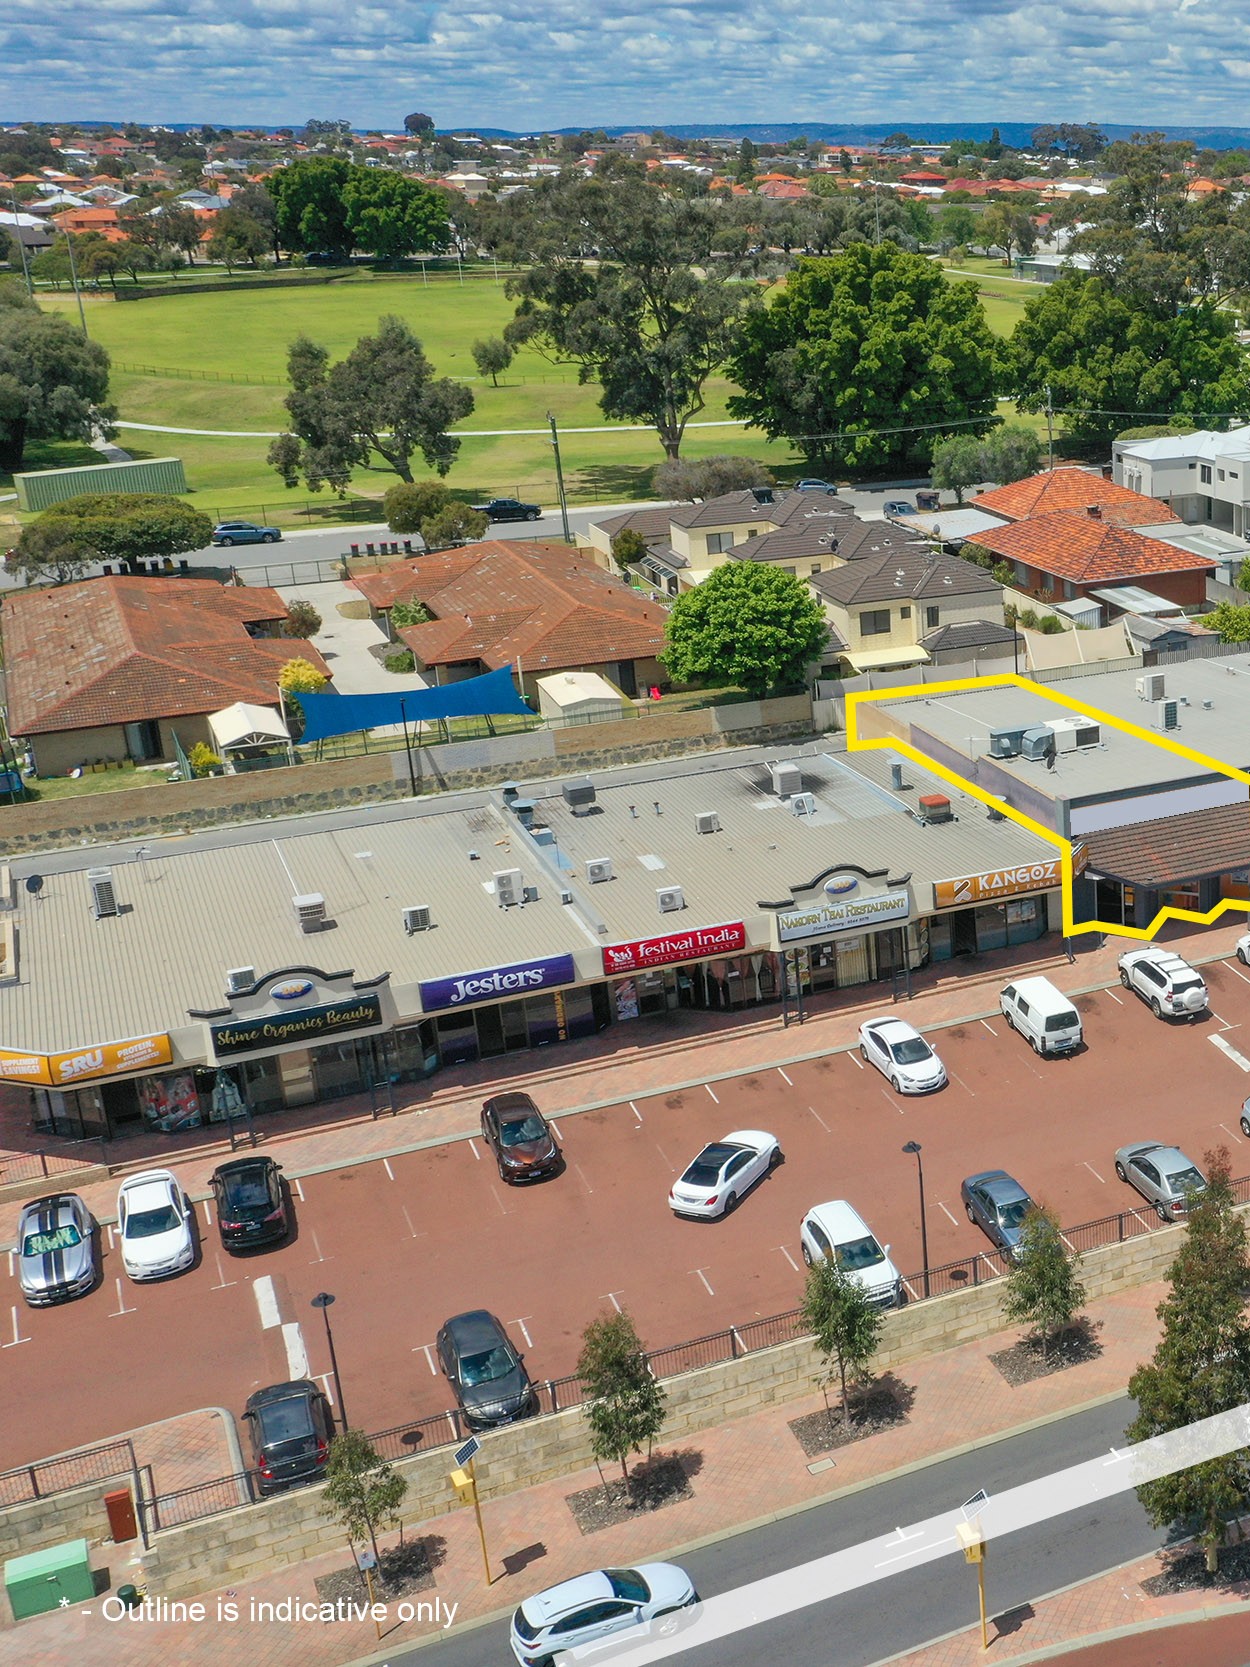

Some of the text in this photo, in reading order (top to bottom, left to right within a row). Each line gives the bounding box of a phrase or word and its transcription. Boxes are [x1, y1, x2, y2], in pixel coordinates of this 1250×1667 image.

[978, 863, 1057, 891] KANGOZ
[979, 889, 1008, 898] Pizza
[1026, 880, 1057, 890] Kebab
[845, 897, 906, 918] RESTAURANT
[637, 928, 740, 957] festival india
[644, 954, 675, 965] INDIAN
[680, 942, 736, 957] RESTAURANT
[450, 968, 544, 1002] Jesters
[217, 1005, 375, 1046] Shine Organics Beauty
[58, 1049, 104, 1077] SRU
